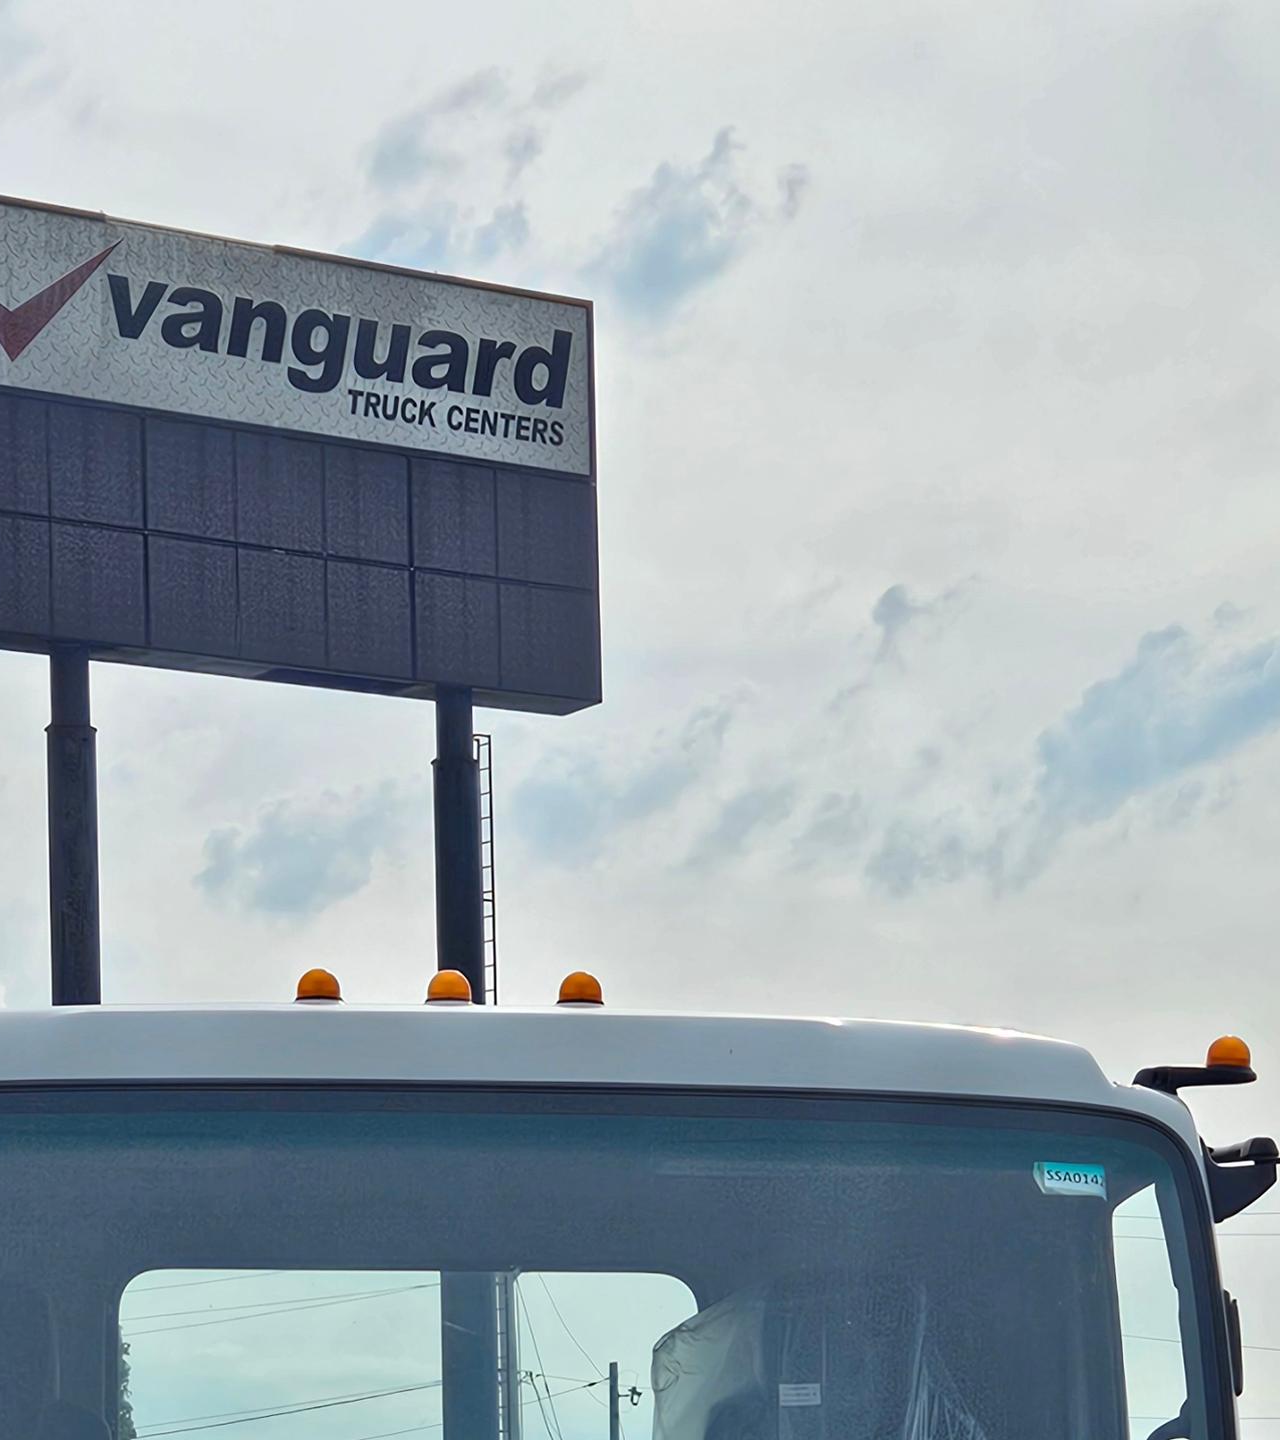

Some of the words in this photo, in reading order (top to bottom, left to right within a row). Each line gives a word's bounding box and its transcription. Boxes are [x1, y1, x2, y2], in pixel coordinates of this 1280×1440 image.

[107, 273, 572, 409] vanguard
[348, 388, 437, 428] TRUCK
[446, 404, 564, 446] CENTERS
